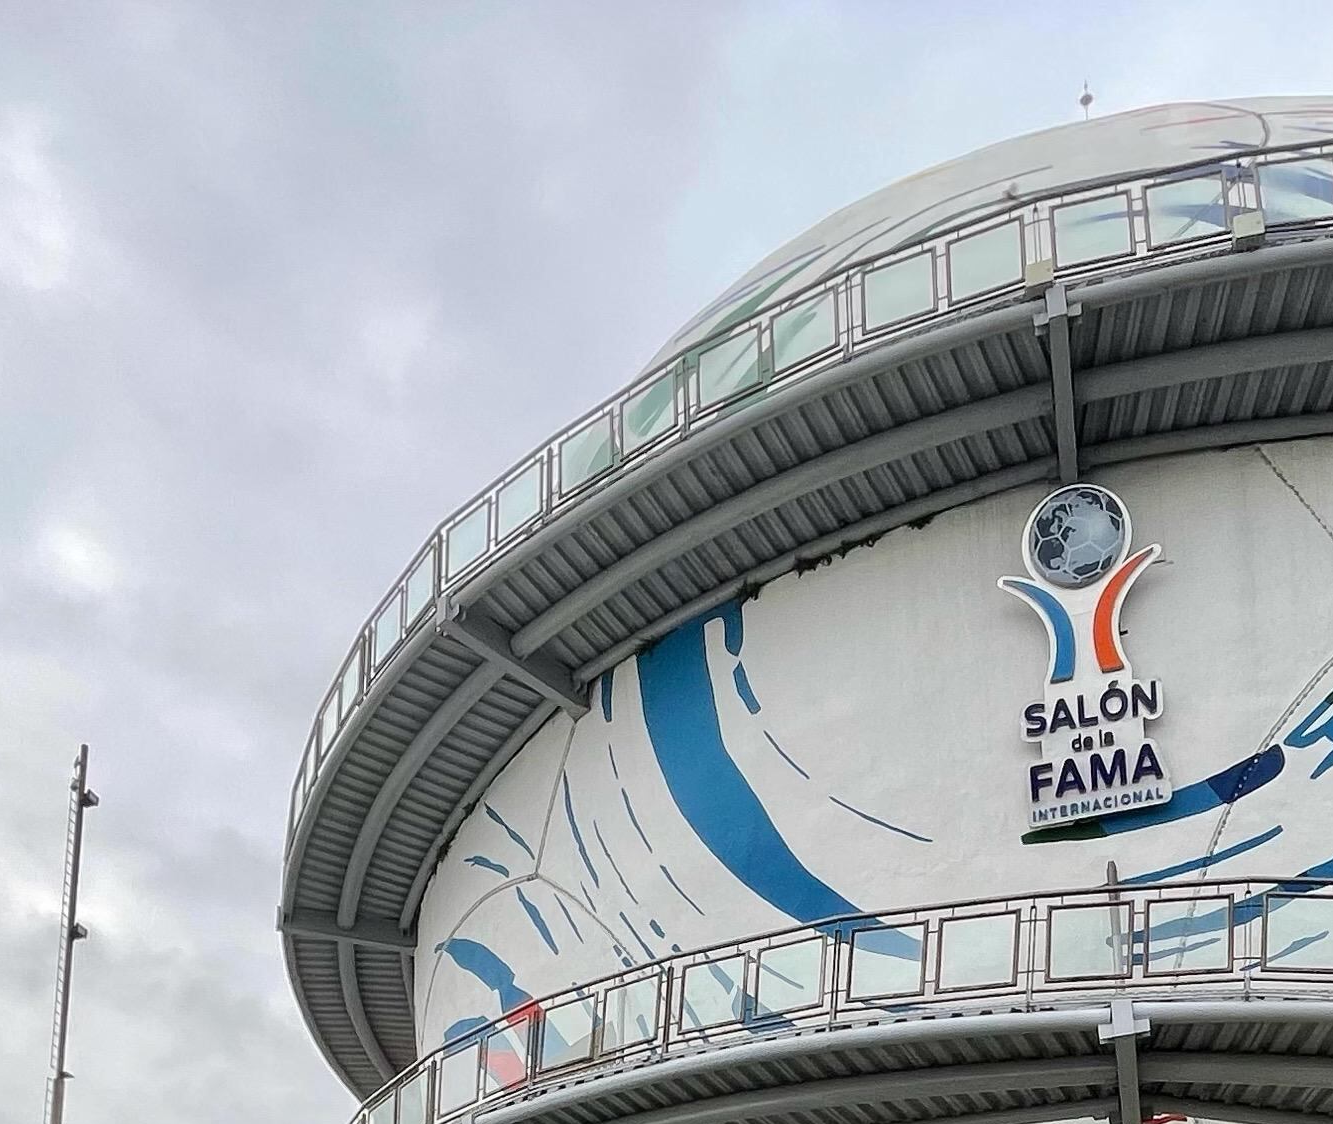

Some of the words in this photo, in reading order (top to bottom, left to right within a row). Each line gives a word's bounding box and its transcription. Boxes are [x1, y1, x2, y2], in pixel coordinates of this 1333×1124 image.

[1024, 680, 1158, 737] SALÓN
[1071, 732, 1094, 752] de
[1098, 728, 1115, 747] la
[1029, 743, 1164, 803] FAMA
[1032, 787, 1164, 823] INTERNACIONAL
